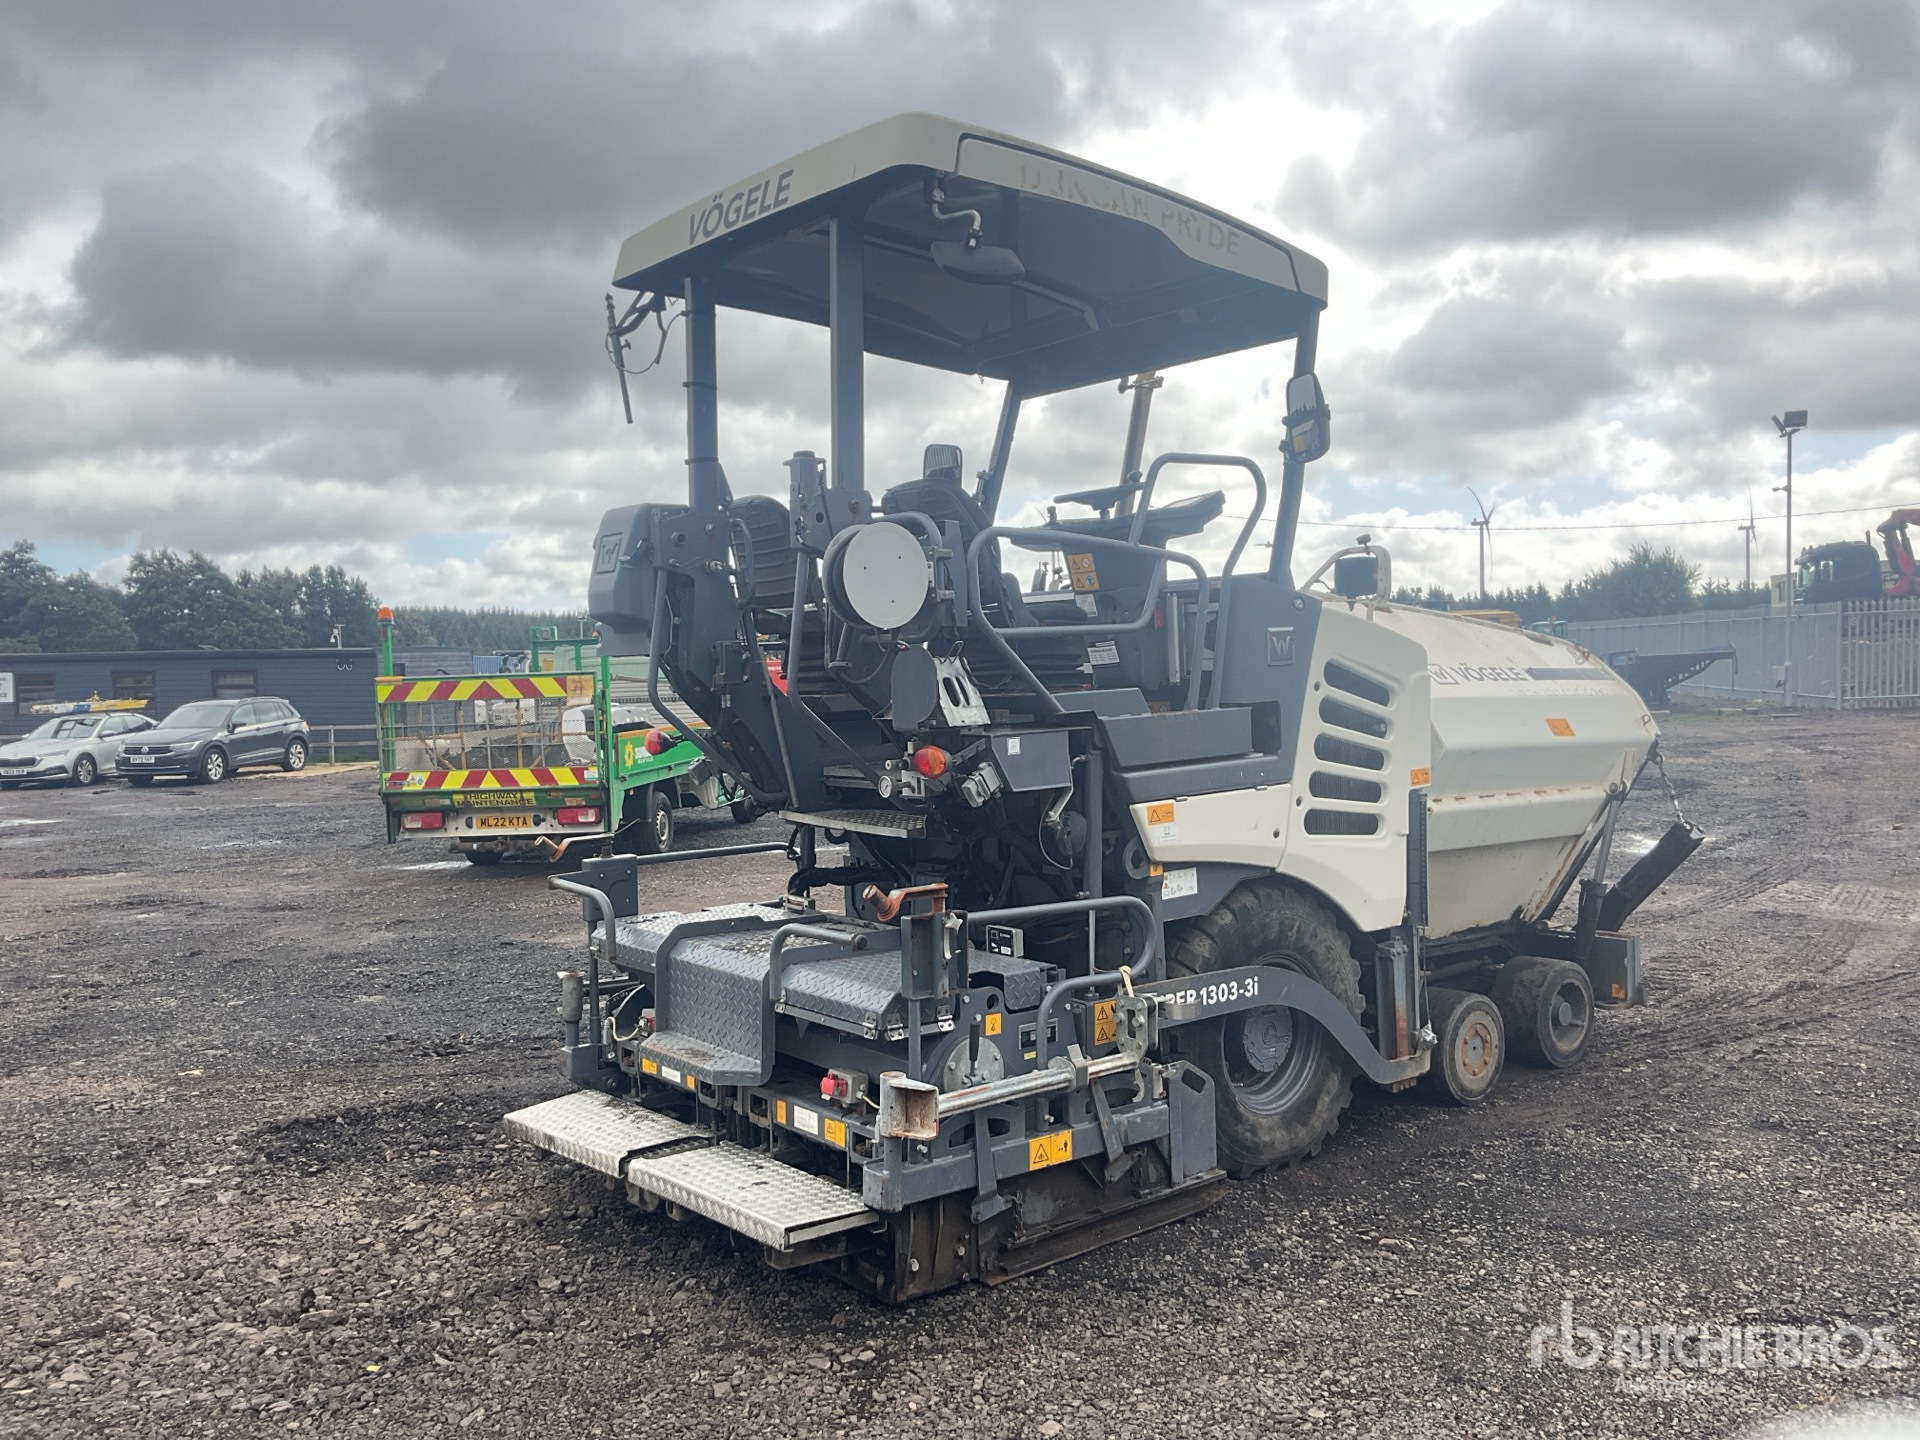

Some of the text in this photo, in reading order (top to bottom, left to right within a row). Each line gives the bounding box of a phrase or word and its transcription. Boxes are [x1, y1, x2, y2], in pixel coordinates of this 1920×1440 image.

[689, 168, 794, 246] VÖGELE
[1449, 662, 1528, 682] VÖGELE
[469, 792, 518, 800] HIGHWAY
[480, 816, 528, 828] ML22 KTA
[1200, 976, 1258, 1005] 1303-3i
